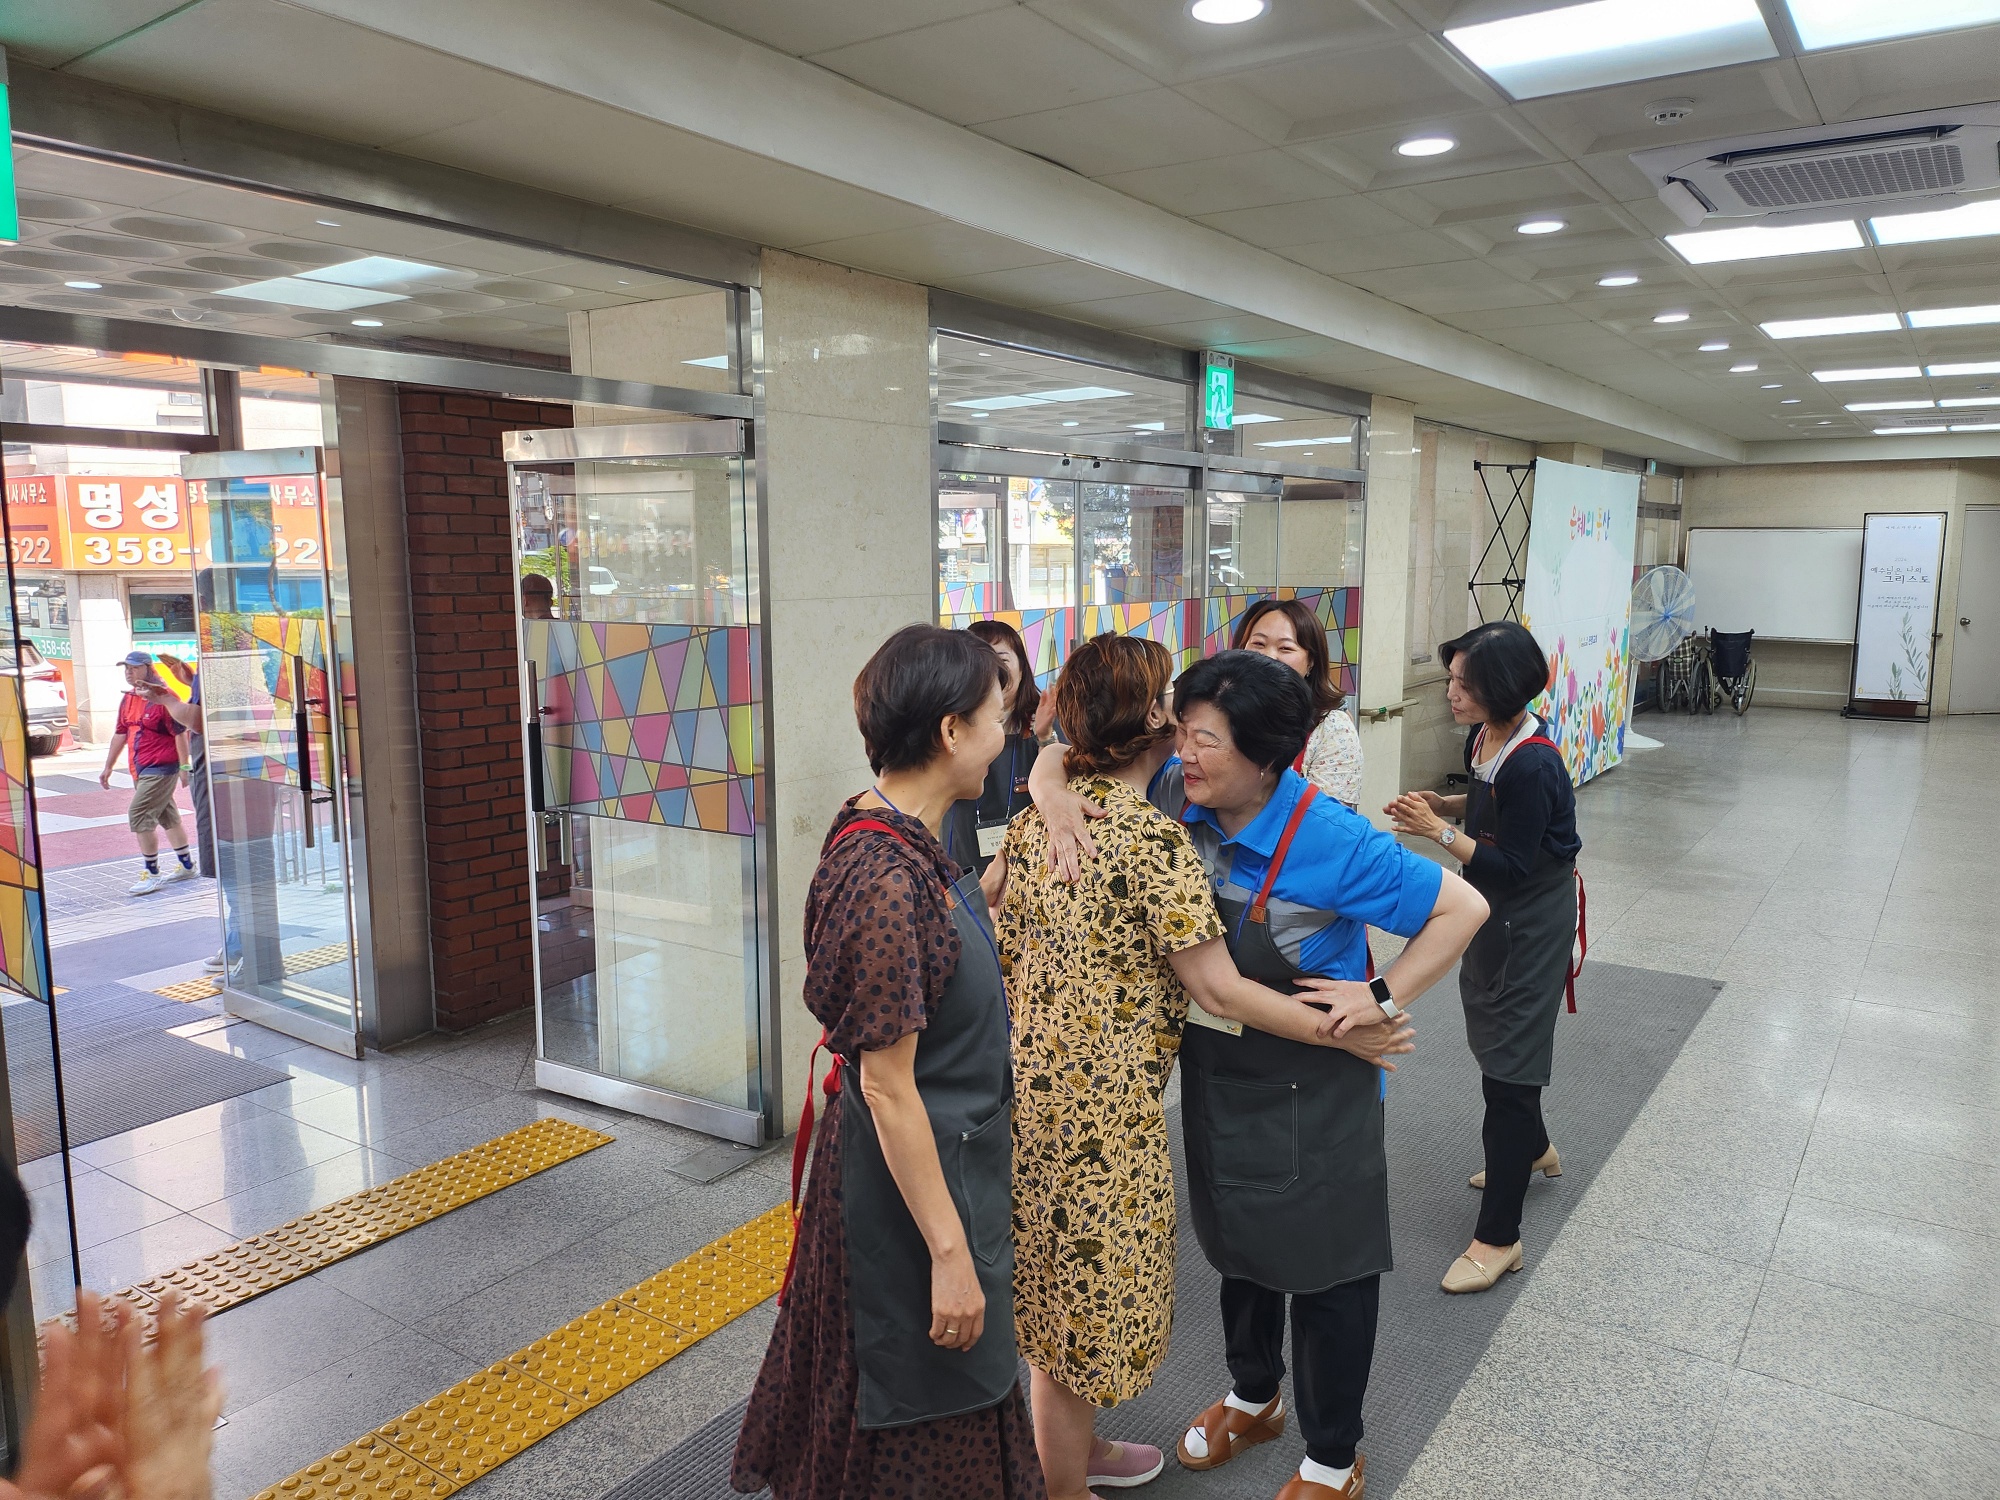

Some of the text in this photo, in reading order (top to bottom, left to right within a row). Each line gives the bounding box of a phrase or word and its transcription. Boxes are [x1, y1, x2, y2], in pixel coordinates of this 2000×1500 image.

[78, 483, 180, 530] 명성
[1570, 505, 1594, 540] 은혜의
[1870, 566, 1922, 576] 예수님은 나의
[1882, 574, 1931, 585] 그리스도
[41, 639, 72, 656] 358-66
